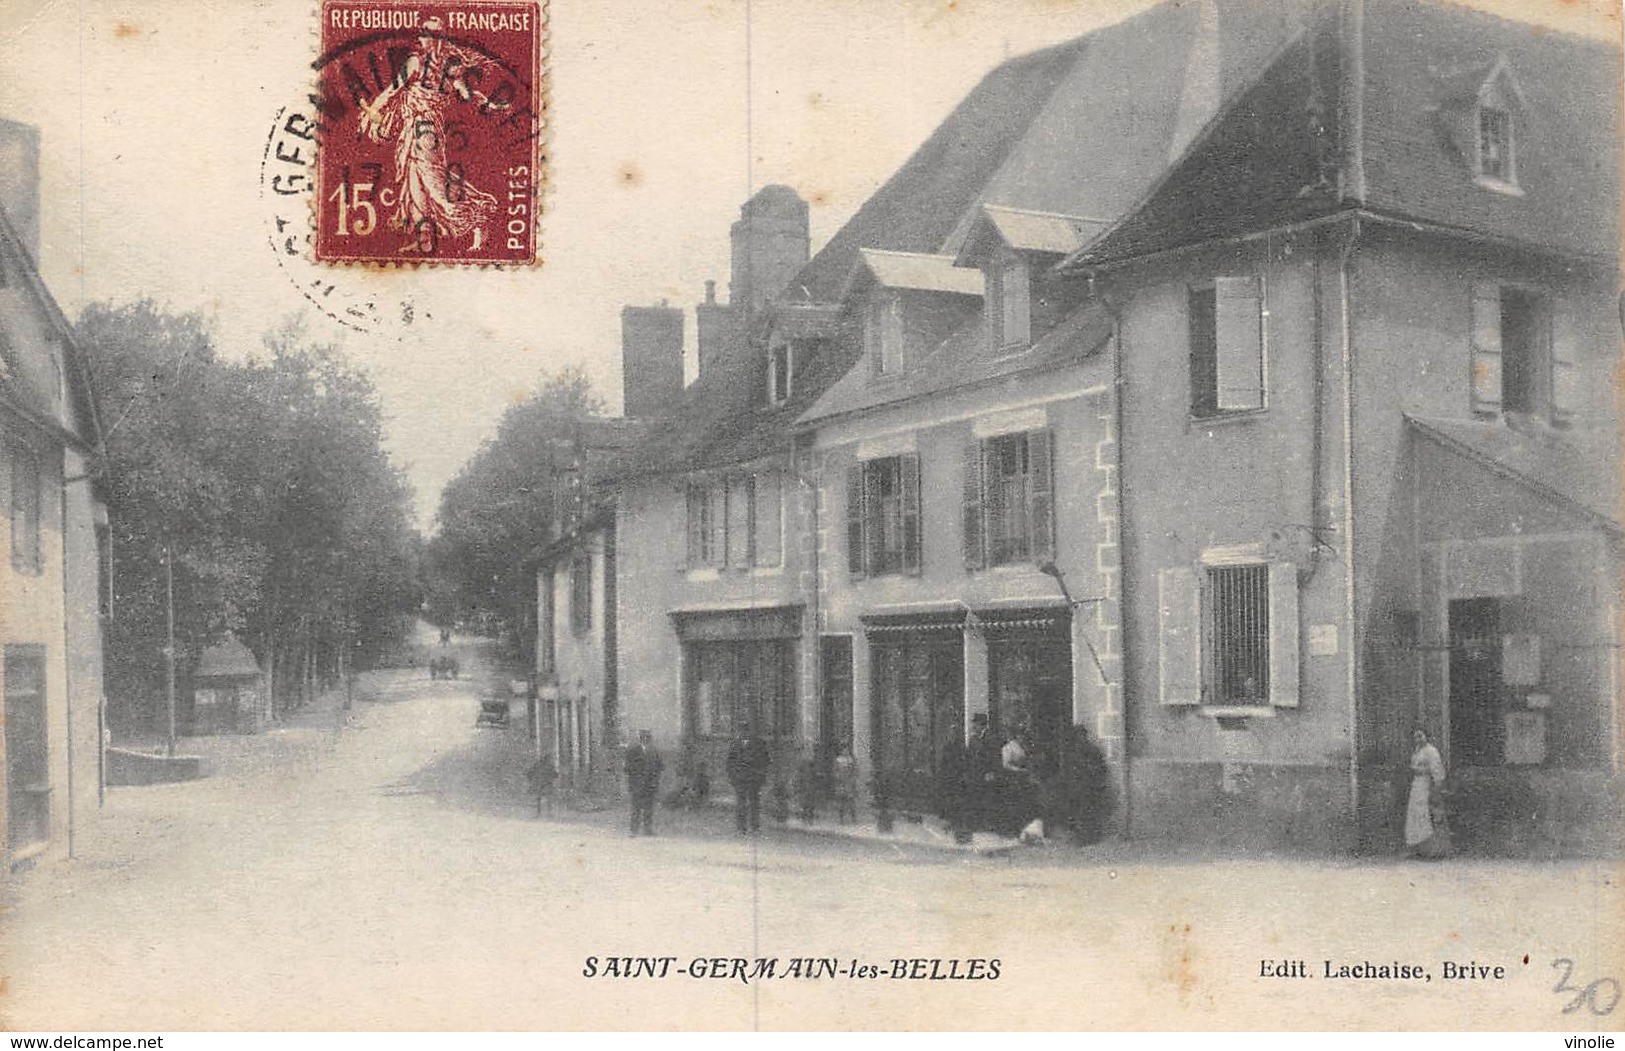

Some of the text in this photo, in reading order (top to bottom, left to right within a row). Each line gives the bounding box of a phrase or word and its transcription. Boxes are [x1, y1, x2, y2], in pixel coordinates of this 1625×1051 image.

[448, 11, 530, 33] FRANÇAISE
[507, 166, 528, 249] POSTES
[1551, 957, 1622, 1016] 30
